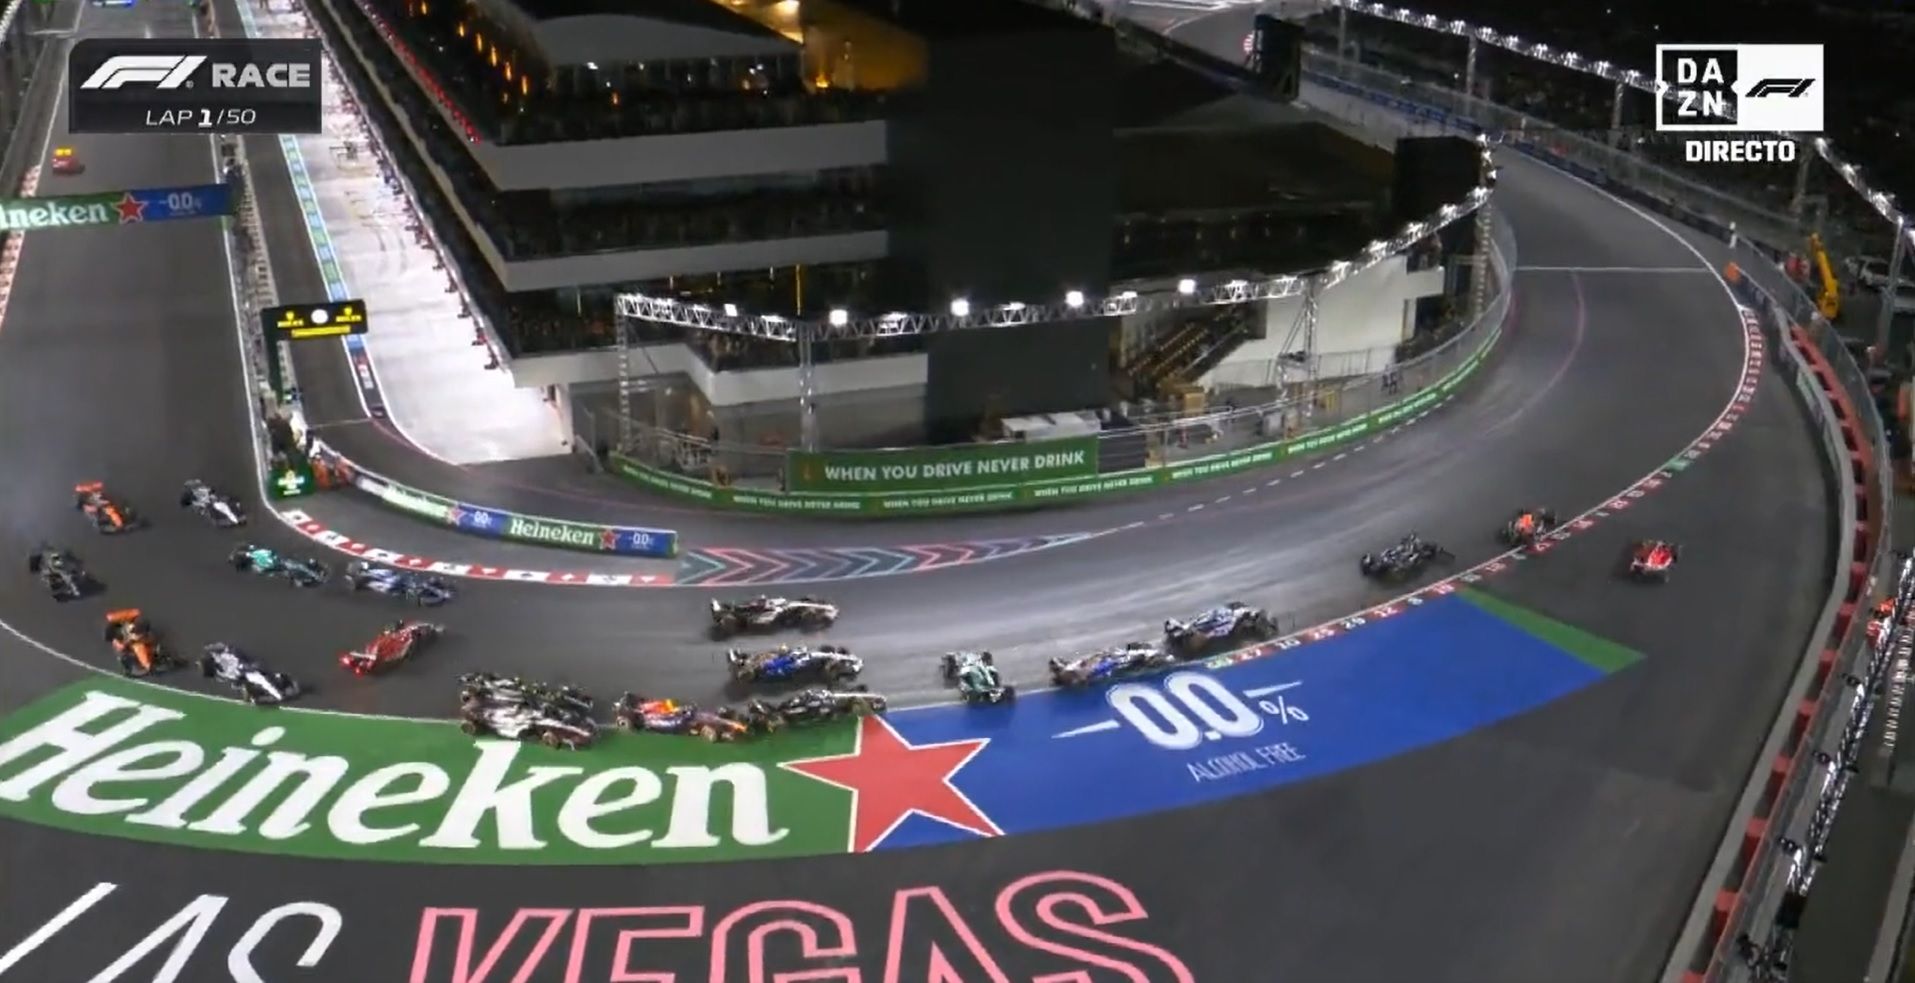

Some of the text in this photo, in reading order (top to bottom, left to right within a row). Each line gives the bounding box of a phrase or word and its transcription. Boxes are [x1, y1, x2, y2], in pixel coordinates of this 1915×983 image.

[824, 450, 1085, 481] WHEN YOU DRIVE NEVER DRINK
[510, 517, 594, 546] Heineken
[0, 689, 790, 851] Heineken
[1187, 742, 1307, 782] ALCOHOL FREE
